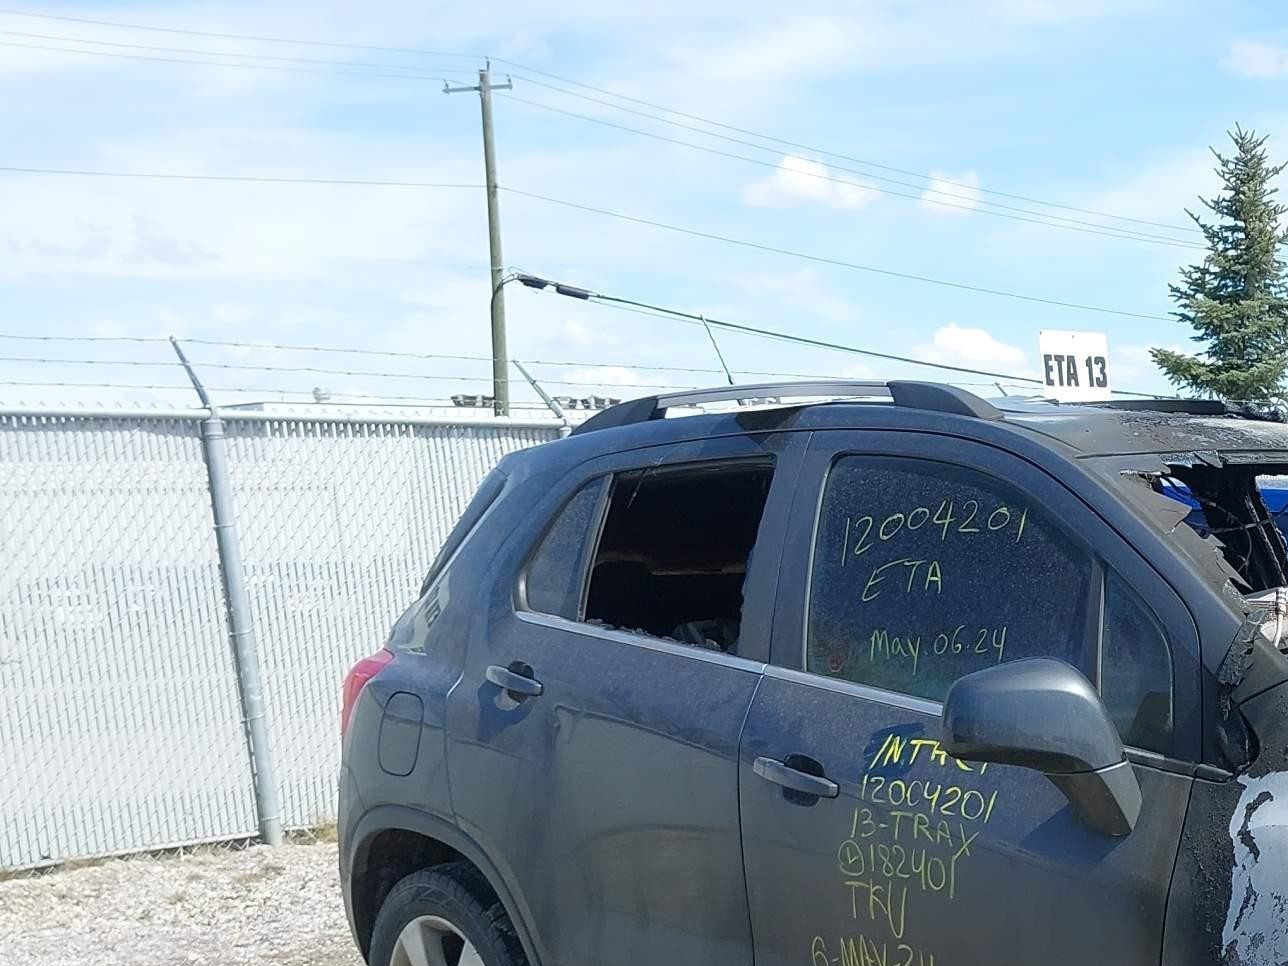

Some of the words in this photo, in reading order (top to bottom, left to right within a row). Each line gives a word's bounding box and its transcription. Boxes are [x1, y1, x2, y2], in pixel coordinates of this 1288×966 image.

[1043, 354, 1080, 387] ETA
[1085, 356, 1108, 388] 13
[842, 499, 1028, 567] 12004201
[862, 558, 942, 602] ETA
[861, 773, 998, 823] 12004201
